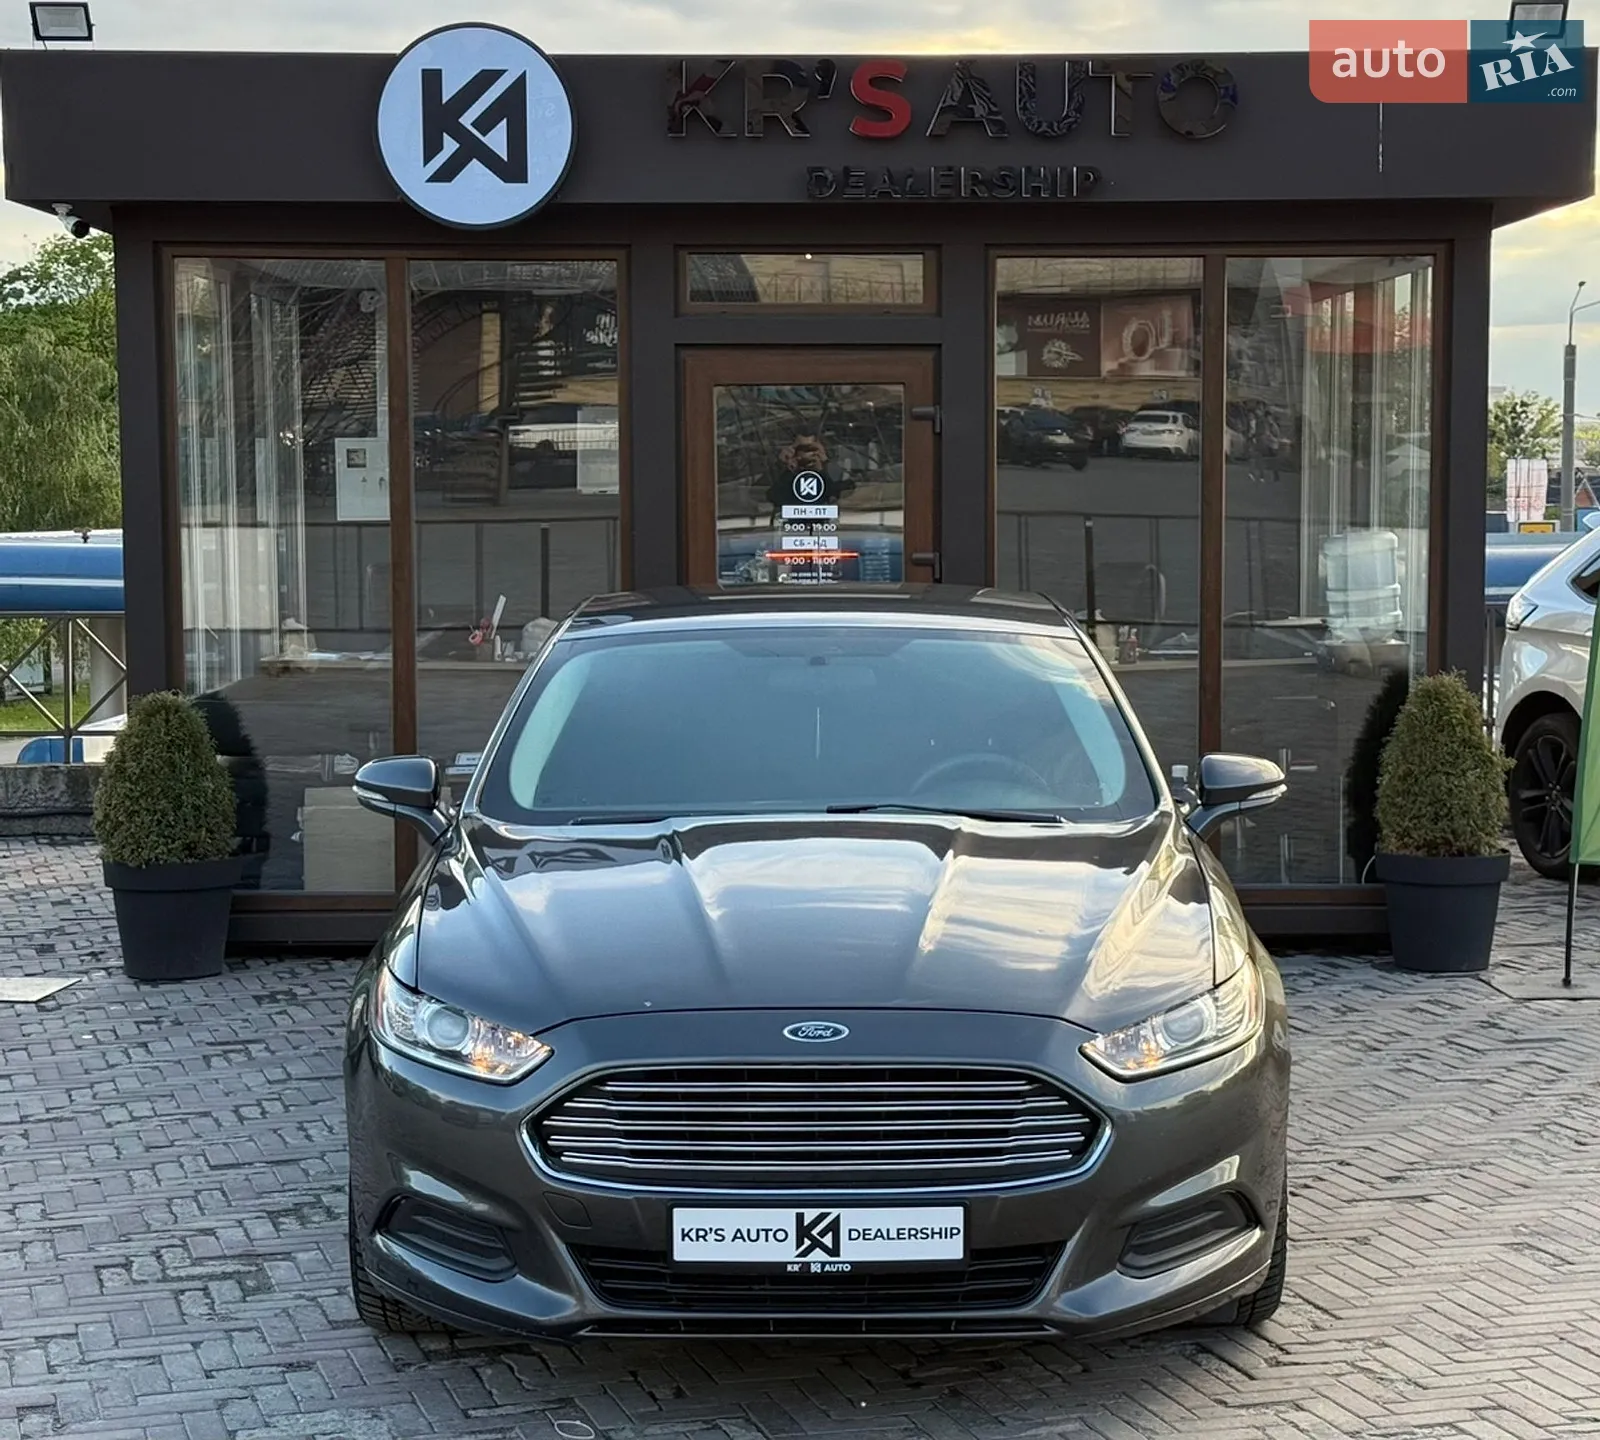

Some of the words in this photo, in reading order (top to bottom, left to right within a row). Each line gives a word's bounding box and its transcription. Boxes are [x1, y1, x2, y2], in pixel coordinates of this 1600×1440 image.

[805, 164, 1101, 200] DEALERSHIP
[793, 508, 807, 516] ПН
[815, 508, 828, 516] ПТ
[798, 1025, 834, 1037] Ford
[681, 1227, 726, 1243] KR'S
[731, 1227, 789, 1243] AUTO
[848, 1226, 962, 1242] DEALERSHIP
[823, 1263, 851, 1272] AUTO
